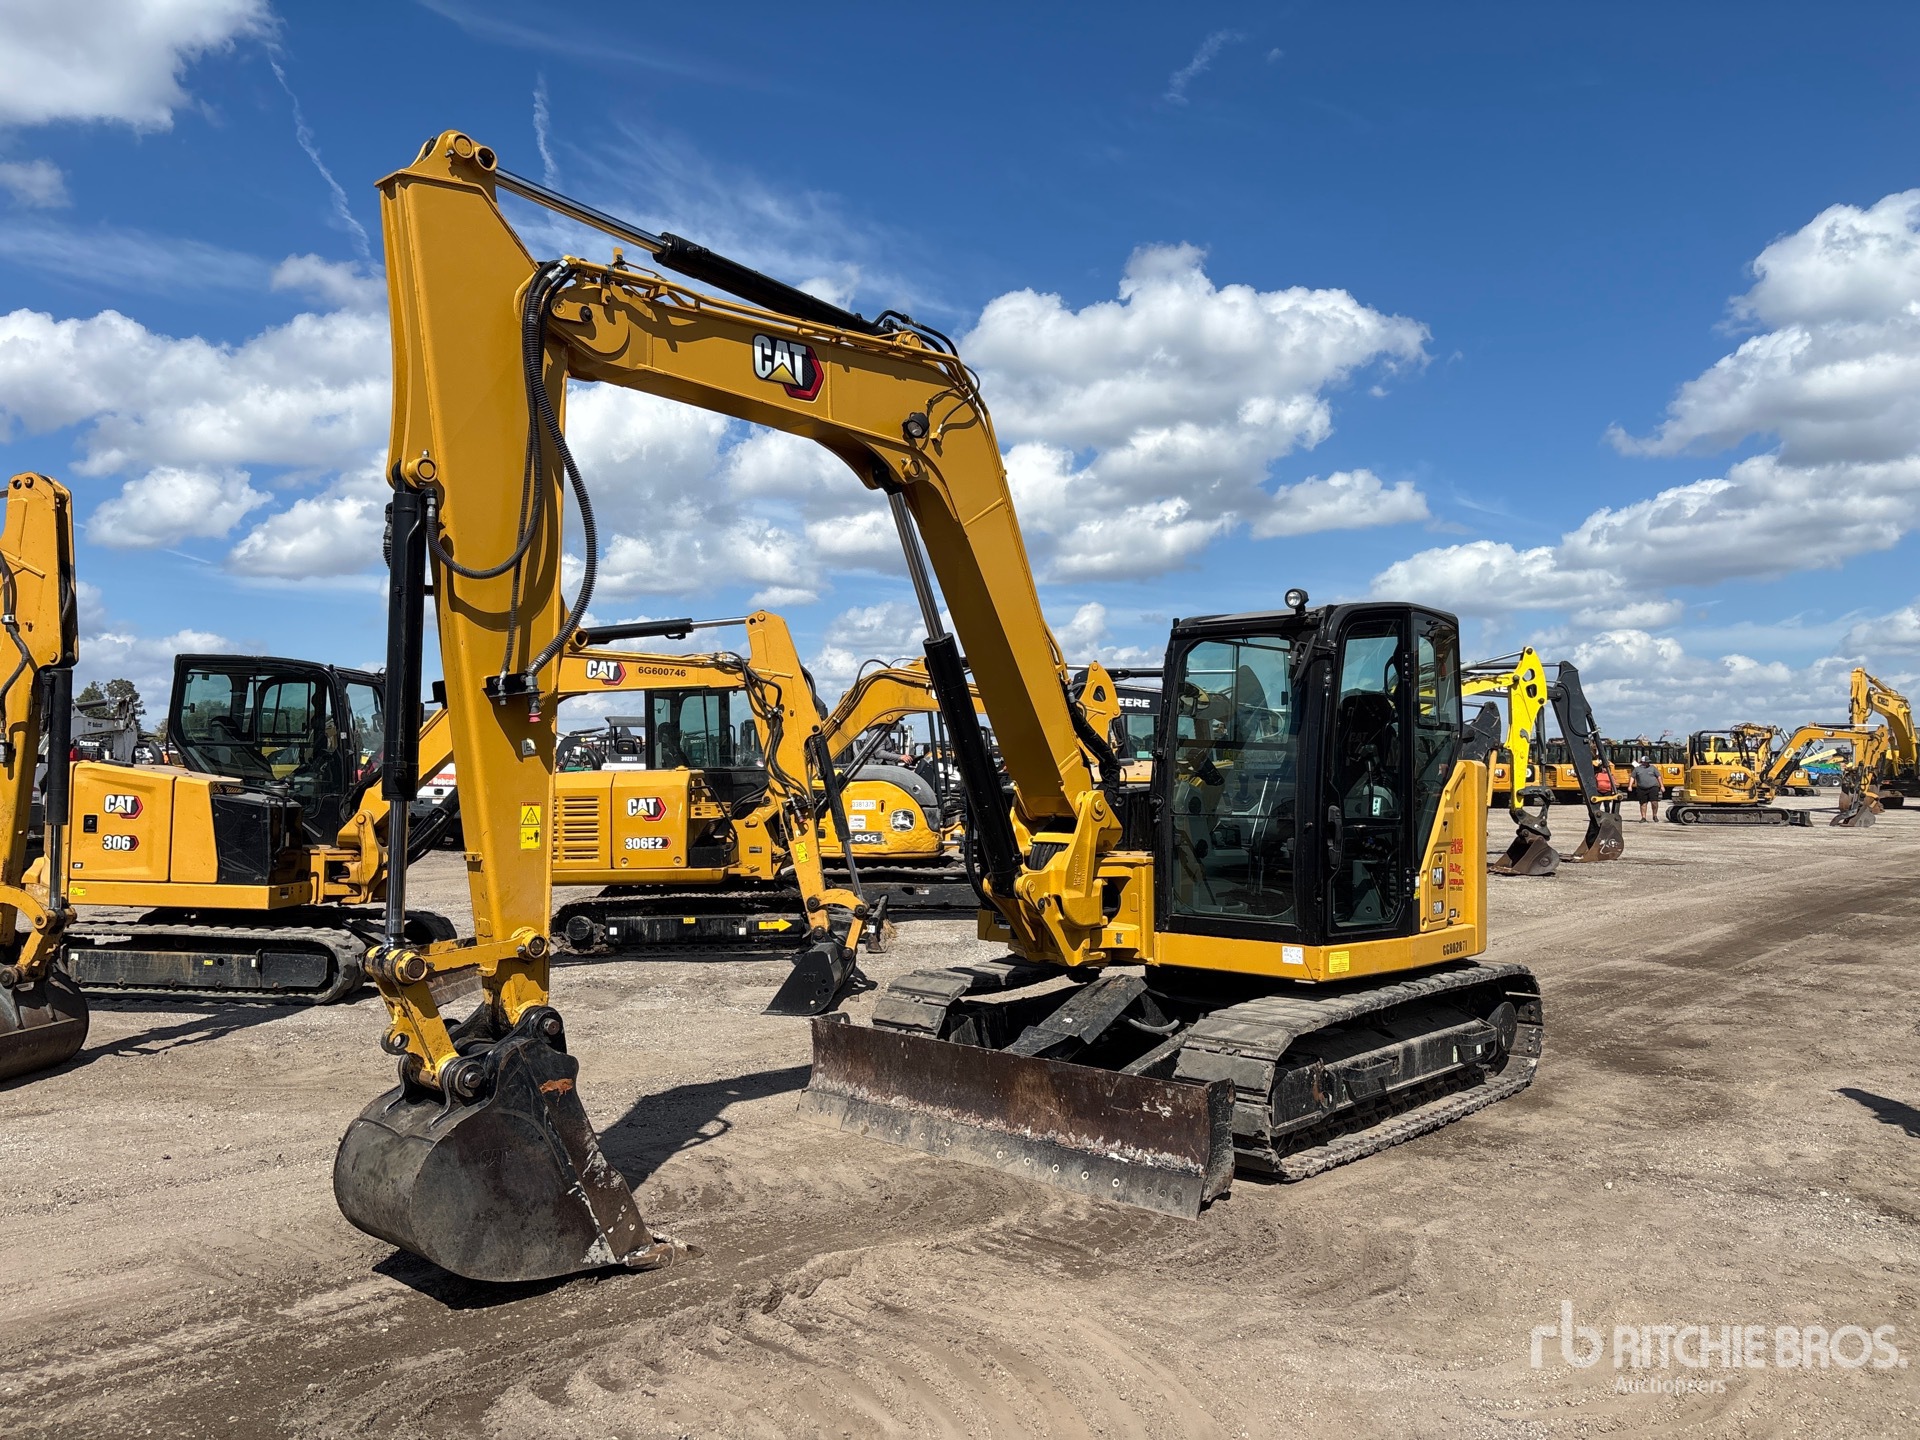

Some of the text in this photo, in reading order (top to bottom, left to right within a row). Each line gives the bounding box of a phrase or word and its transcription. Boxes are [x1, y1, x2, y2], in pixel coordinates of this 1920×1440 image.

[753, 334, 807, 387] CAT
[586, 660, 617, 680] CAT
[637, 666, 687, 677] 6G600746
[1117, 697, 1151, 708] EERE
[103, 794, 134, 813] CAT
[627, 798, 657, 816] CAT
[103, 835, 131, 850] 306
[624, 838, 664, 850] 306E2
[854, 834, 878, 842] 60G
